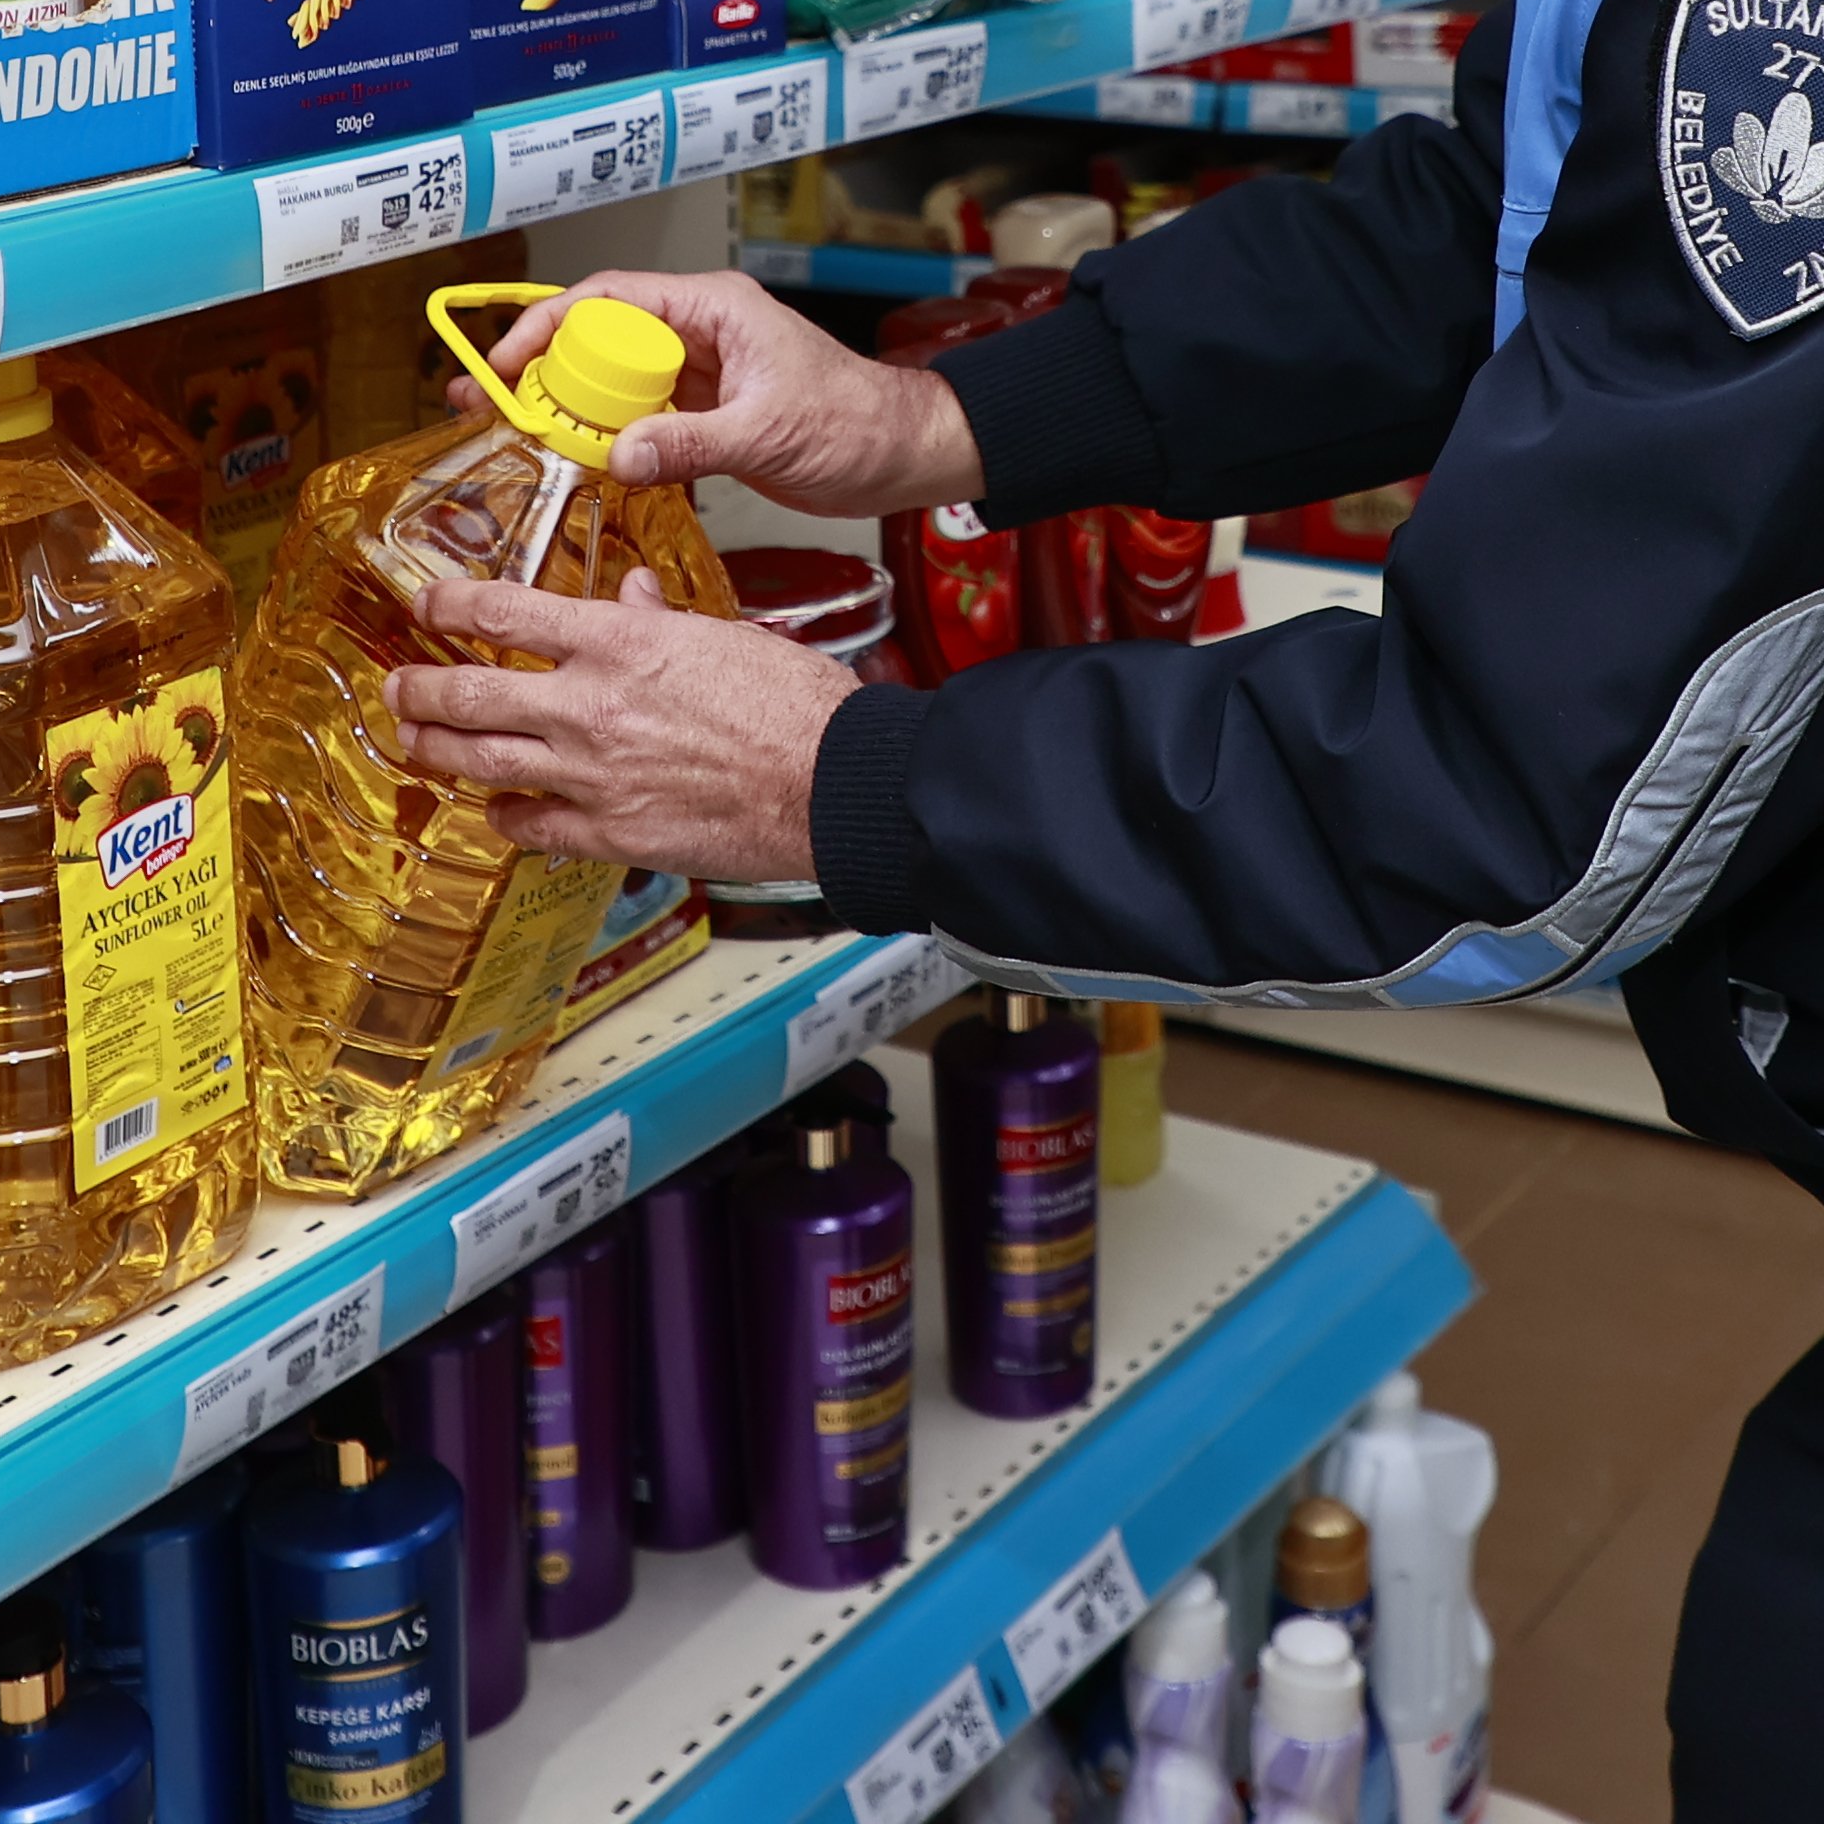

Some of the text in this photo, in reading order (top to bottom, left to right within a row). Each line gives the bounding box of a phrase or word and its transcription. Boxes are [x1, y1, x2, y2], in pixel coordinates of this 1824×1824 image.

[232, 78, 268, 95] ÖZENLE
[268, 69, 306, 90] SEÇİLMİŞ
[307, 66, 337, 83] DURUM
[337, 56, 391, 77] BUĞDAYINDAN
[390, 51, 415, 69] GELEN
[279, 183, 354, 208] MAKARNA BURGU
[1674, 89, 1745, 275] BELEDİYE
[108, 798, 186, 876] Kent
[146, 838, 186, 876] boringer
[81, 853, 219, 941] AYÇİÇEK YAĞI
[94, 890, 211, 960] SUNFLOWER OIL
[290, 1614, 430, 1667] BIOBLAS
[294, 1704, 372, 1727] KEPEĞE
